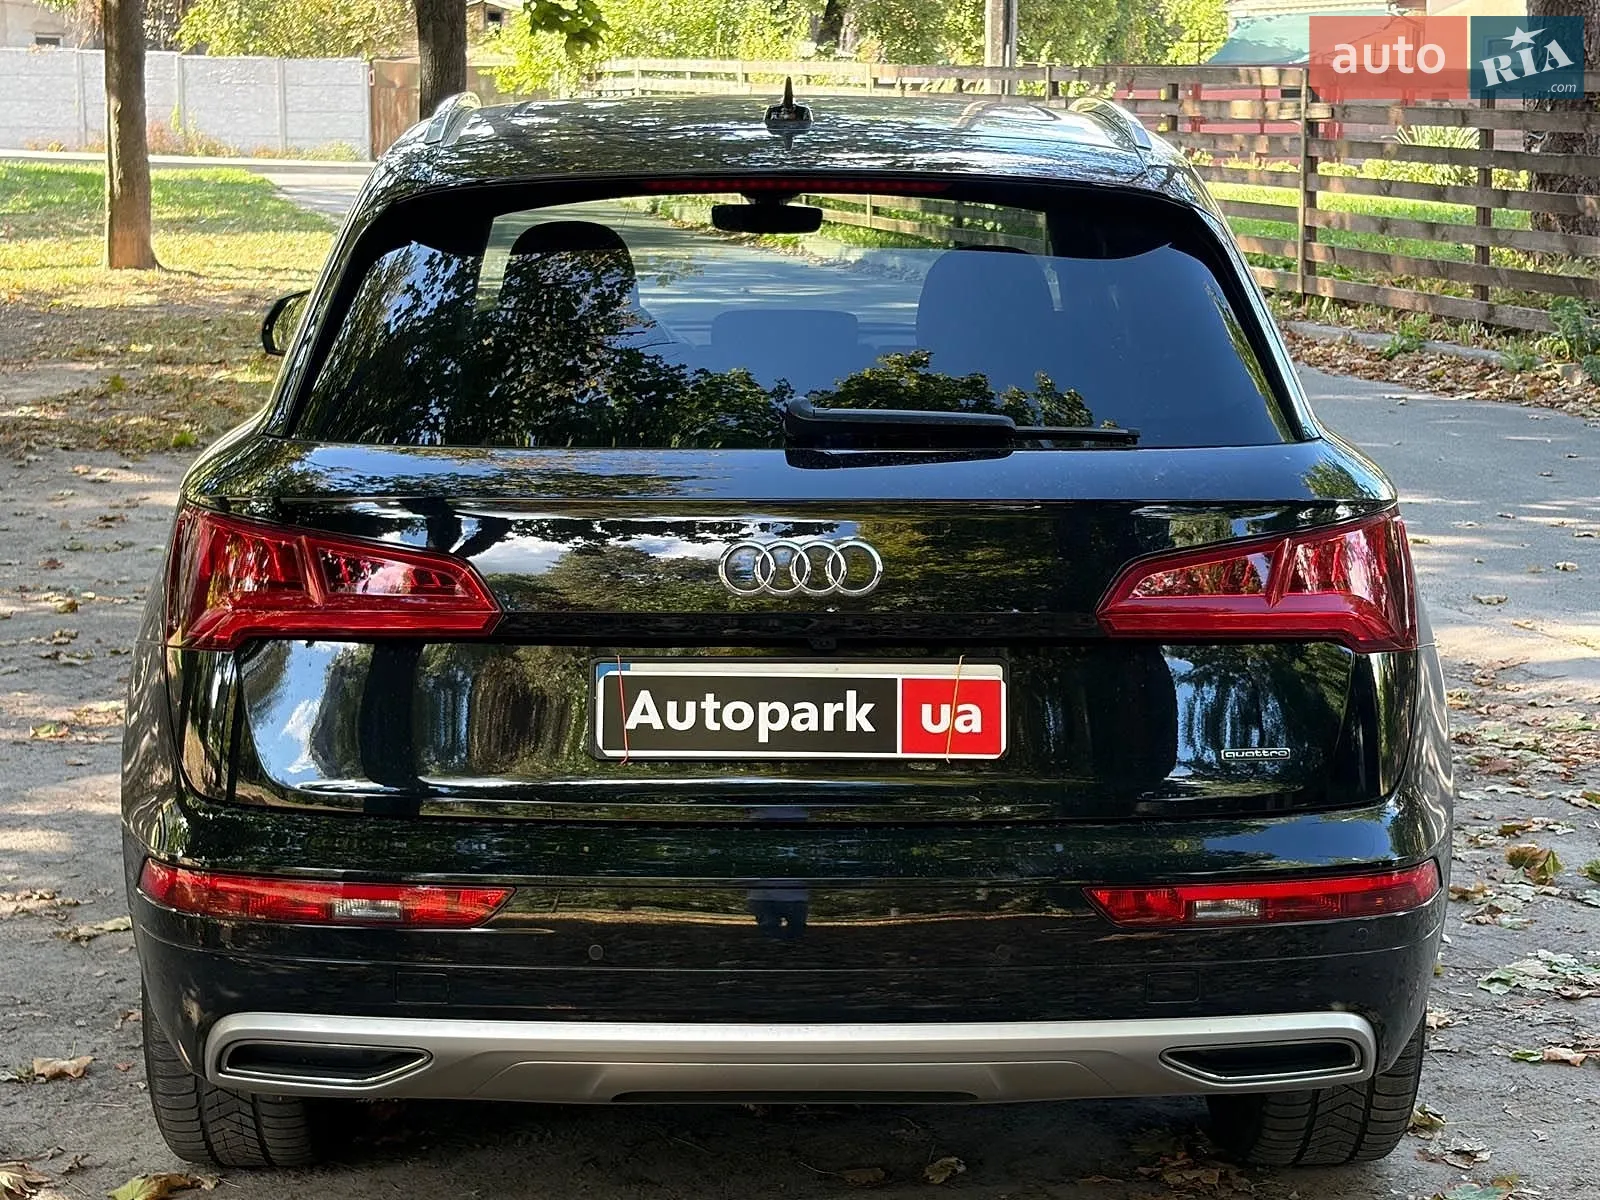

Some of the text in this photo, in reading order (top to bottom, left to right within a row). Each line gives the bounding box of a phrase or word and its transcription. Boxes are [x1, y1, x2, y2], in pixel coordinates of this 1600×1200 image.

[625, 690, 982, 743] Autopark ua
[1224, 749, 1288, 759] quattro
